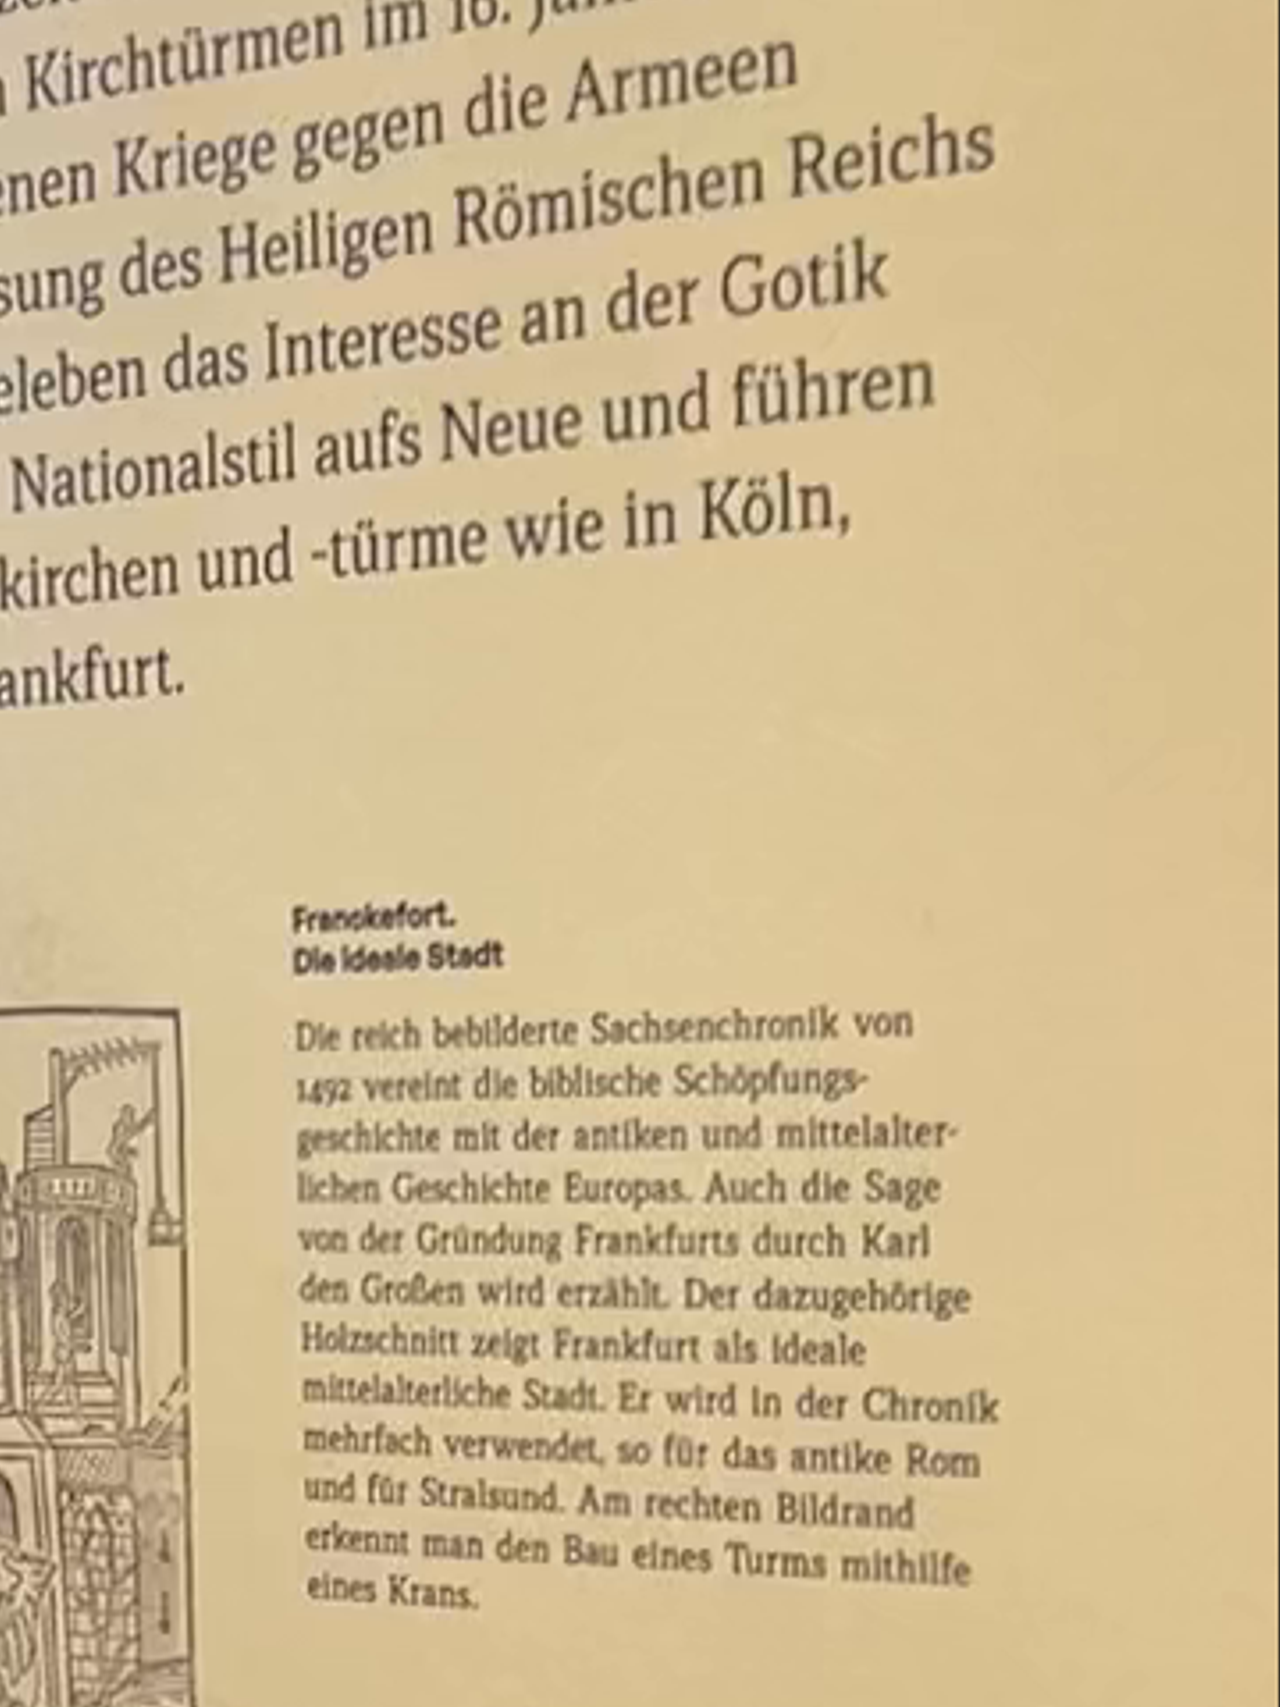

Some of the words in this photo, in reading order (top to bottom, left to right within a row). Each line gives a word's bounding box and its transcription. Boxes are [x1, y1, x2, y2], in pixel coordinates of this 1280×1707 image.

[25, 13, 344, 112] Kirchtürmen
[119, 236, 203, 297] des
[218, 208, 433, 284] Heiligen
[453, 152, 764, 248] Römischen
[788, 112, 995, 198] Reichs
[10, 420, 296, 514] Nationalstil
[314, 406, 422, 478] aufs
[440, 398, 583, 462] Neue
[602, 368, 710, 443] und
[732, 356, 934, 428] führen
[293, 946, 336, 976] Die
[340, 942, 422, 973] ideale
[427, 940, 504, 971] Stadt
[296, 1021, 340, 1051] Die
[352, 1017, 421, 1051] reich
[432, 1014, 578, 1049] bebilderte
[591, 1005, 838, 1045] Sachsenchronik
[854, 1012, 913, 1037] von
[362, 1071, 461, 1102] vereint
[473, 1066, 518, 1100] die
[529, 1064, 661, 1099] biblische
[674, 1060, 868, 1104] Schöpfungs-
[297, 1119, 440, 1160] geschichte
[454, 1121, 500, 1152] mit
[512, 1118, 560, 1151] der
[574, 1117, 687, 1151] antiken
[702, 1115, 761, 1150] und
[777, 1113, 956, 1149] mittelalter-
[298, 1230, 348, 1253] von
[359, 1221, 404, 1254] der
[416, 1222, 561, 1264] Gründung
[575, 1222, 739, 1257] Frankfurts
[752, 1222, 845, 1257] durch
[862, 1223, 930, 1258] Karl
[299, 1272, 349, 1303] den
[361, 1272, 465, 1306] Großen
[477, 1275, 544, 1308] wird
[557, 1275, 670, 1309] erzählt.
[684, 1276, 740, 1310] Der
[753, 1277, 971, 1321] dazugehörige
[303, 1373, 511, 1408] mittelalterliche
[523, 1377, 606, 1412] Stadt.
[618, 1380, 651, 1413] Er
[665, 1383, 736, 1416] wird
[752, 1386, 781, 1417] in
[796, 1385, 848, 1420] der
[862, 1387, 998, 1423] Chronik
[305, 1472, 355, 1503] und
[368, 1472, 407, 1506] für
[420, 1476, 564, 1512] Stralsund.
[577, 1484, 631, 1516] Am
[645, 1486, 761, 1523] rechten
[777, 1491, 914, 1529] Bildrand
